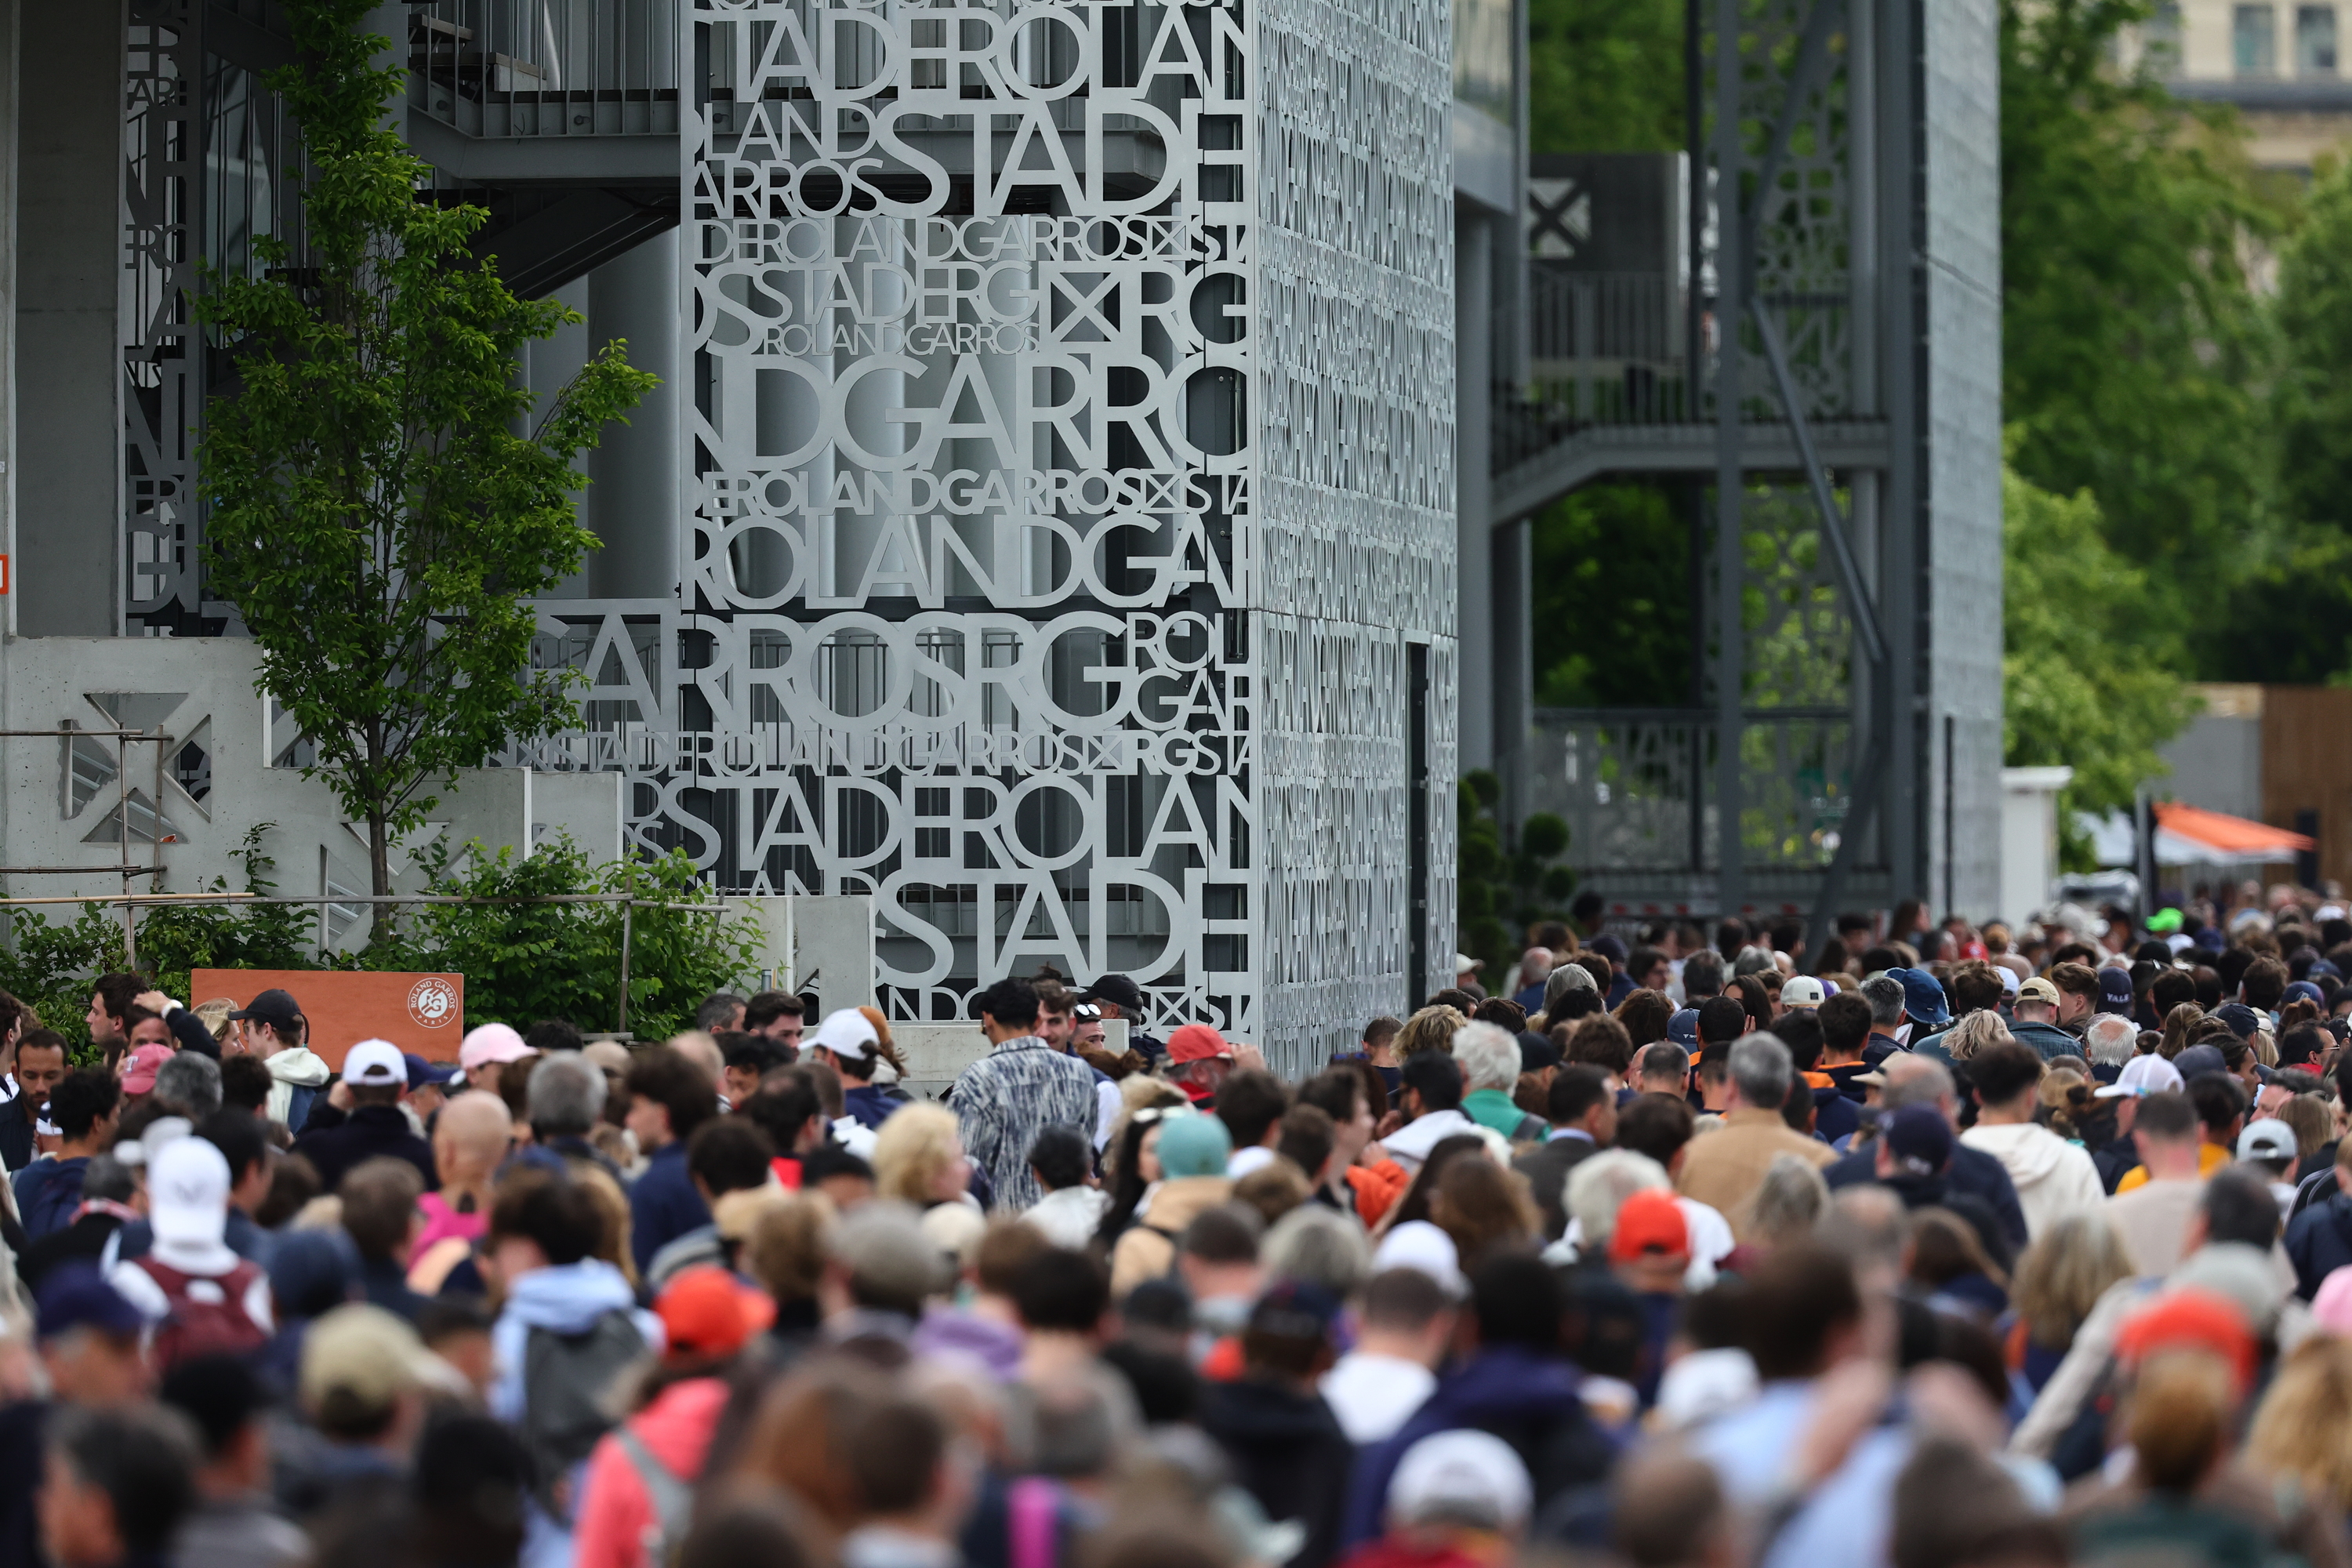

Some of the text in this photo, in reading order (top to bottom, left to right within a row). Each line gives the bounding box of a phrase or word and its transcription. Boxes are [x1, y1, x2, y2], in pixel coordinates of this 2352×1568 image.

[877, 100, 1248, 219] STADE
[411, 980, 456, 1009] ROLAND GARROS
[2107, 993, 2129, 1004] YALE
[417, 1014, 448, 1025] PARIS
